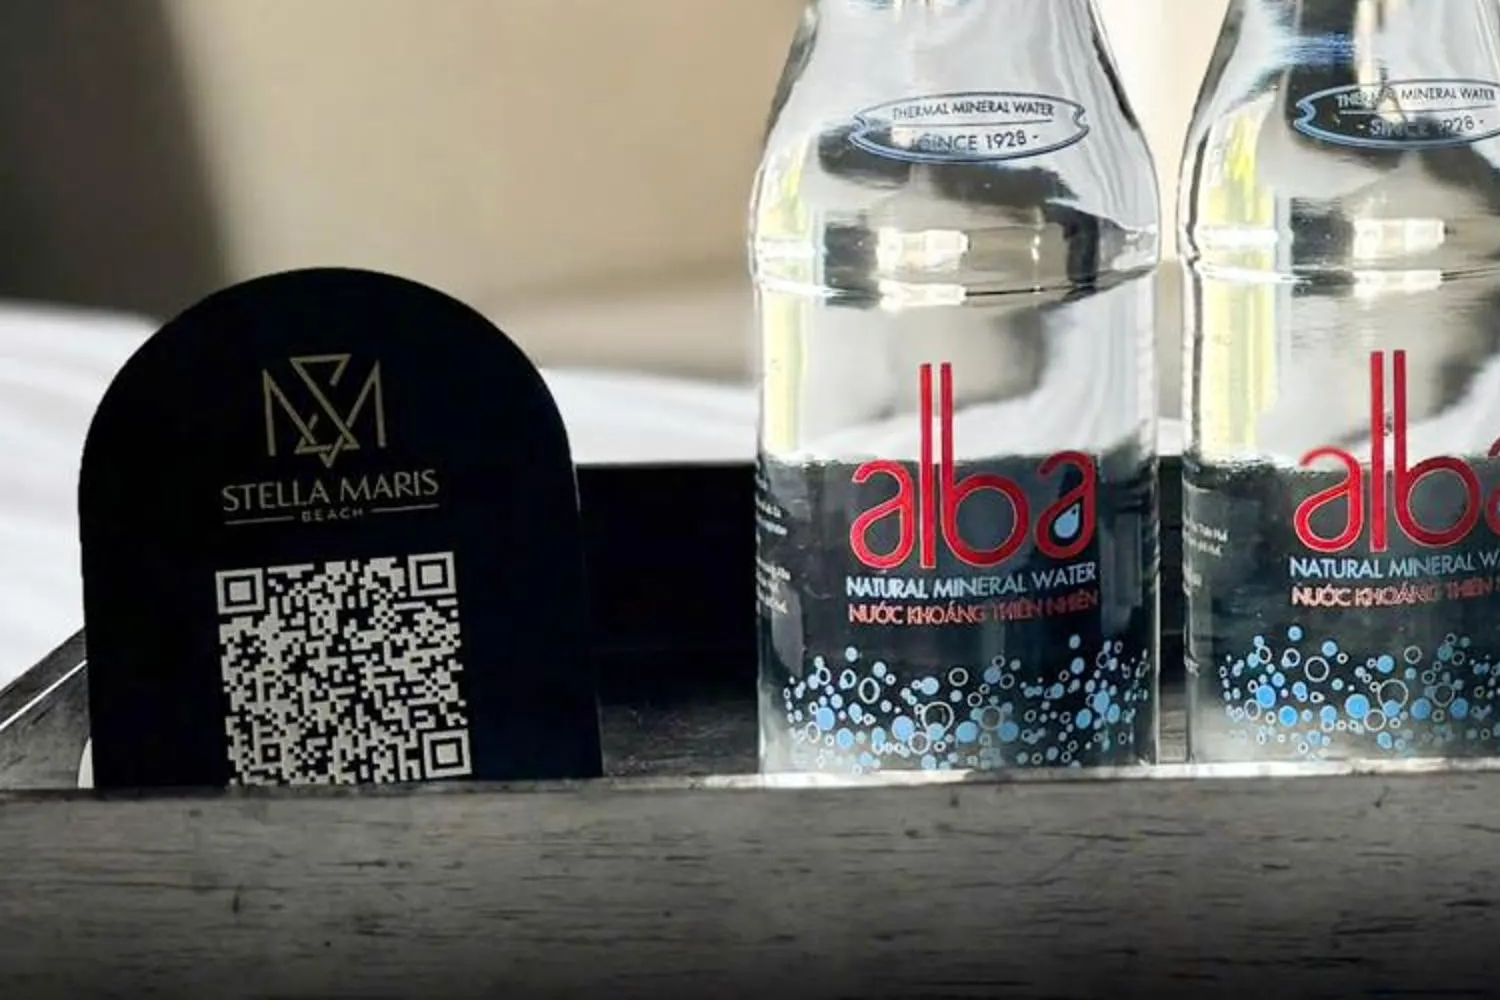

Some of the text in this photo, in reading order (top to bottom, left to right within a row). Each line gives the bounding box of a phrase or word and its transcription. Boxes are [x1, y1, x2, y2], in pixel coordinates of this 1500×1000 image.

[1401, 87, 1457, 101] MINERAL
[1459, 88, 1496, 101] WATER
[952, 100, 1009, 114] MINERAL
[1013, 101, 1055, 116] WATER
[986, 129, 1027, 149] 1928
[850, 361, 1099, 569] alba
[221, 469, 439, 512] STELLA MARIS
[301, 507, 364, 523] BEACH
[1289, 555, 1384, 579] NATURAL
[1388, 552, 1476, 578] MINERAL
[846, 561, 1097, 599] NATURAL MINERAL WATER
